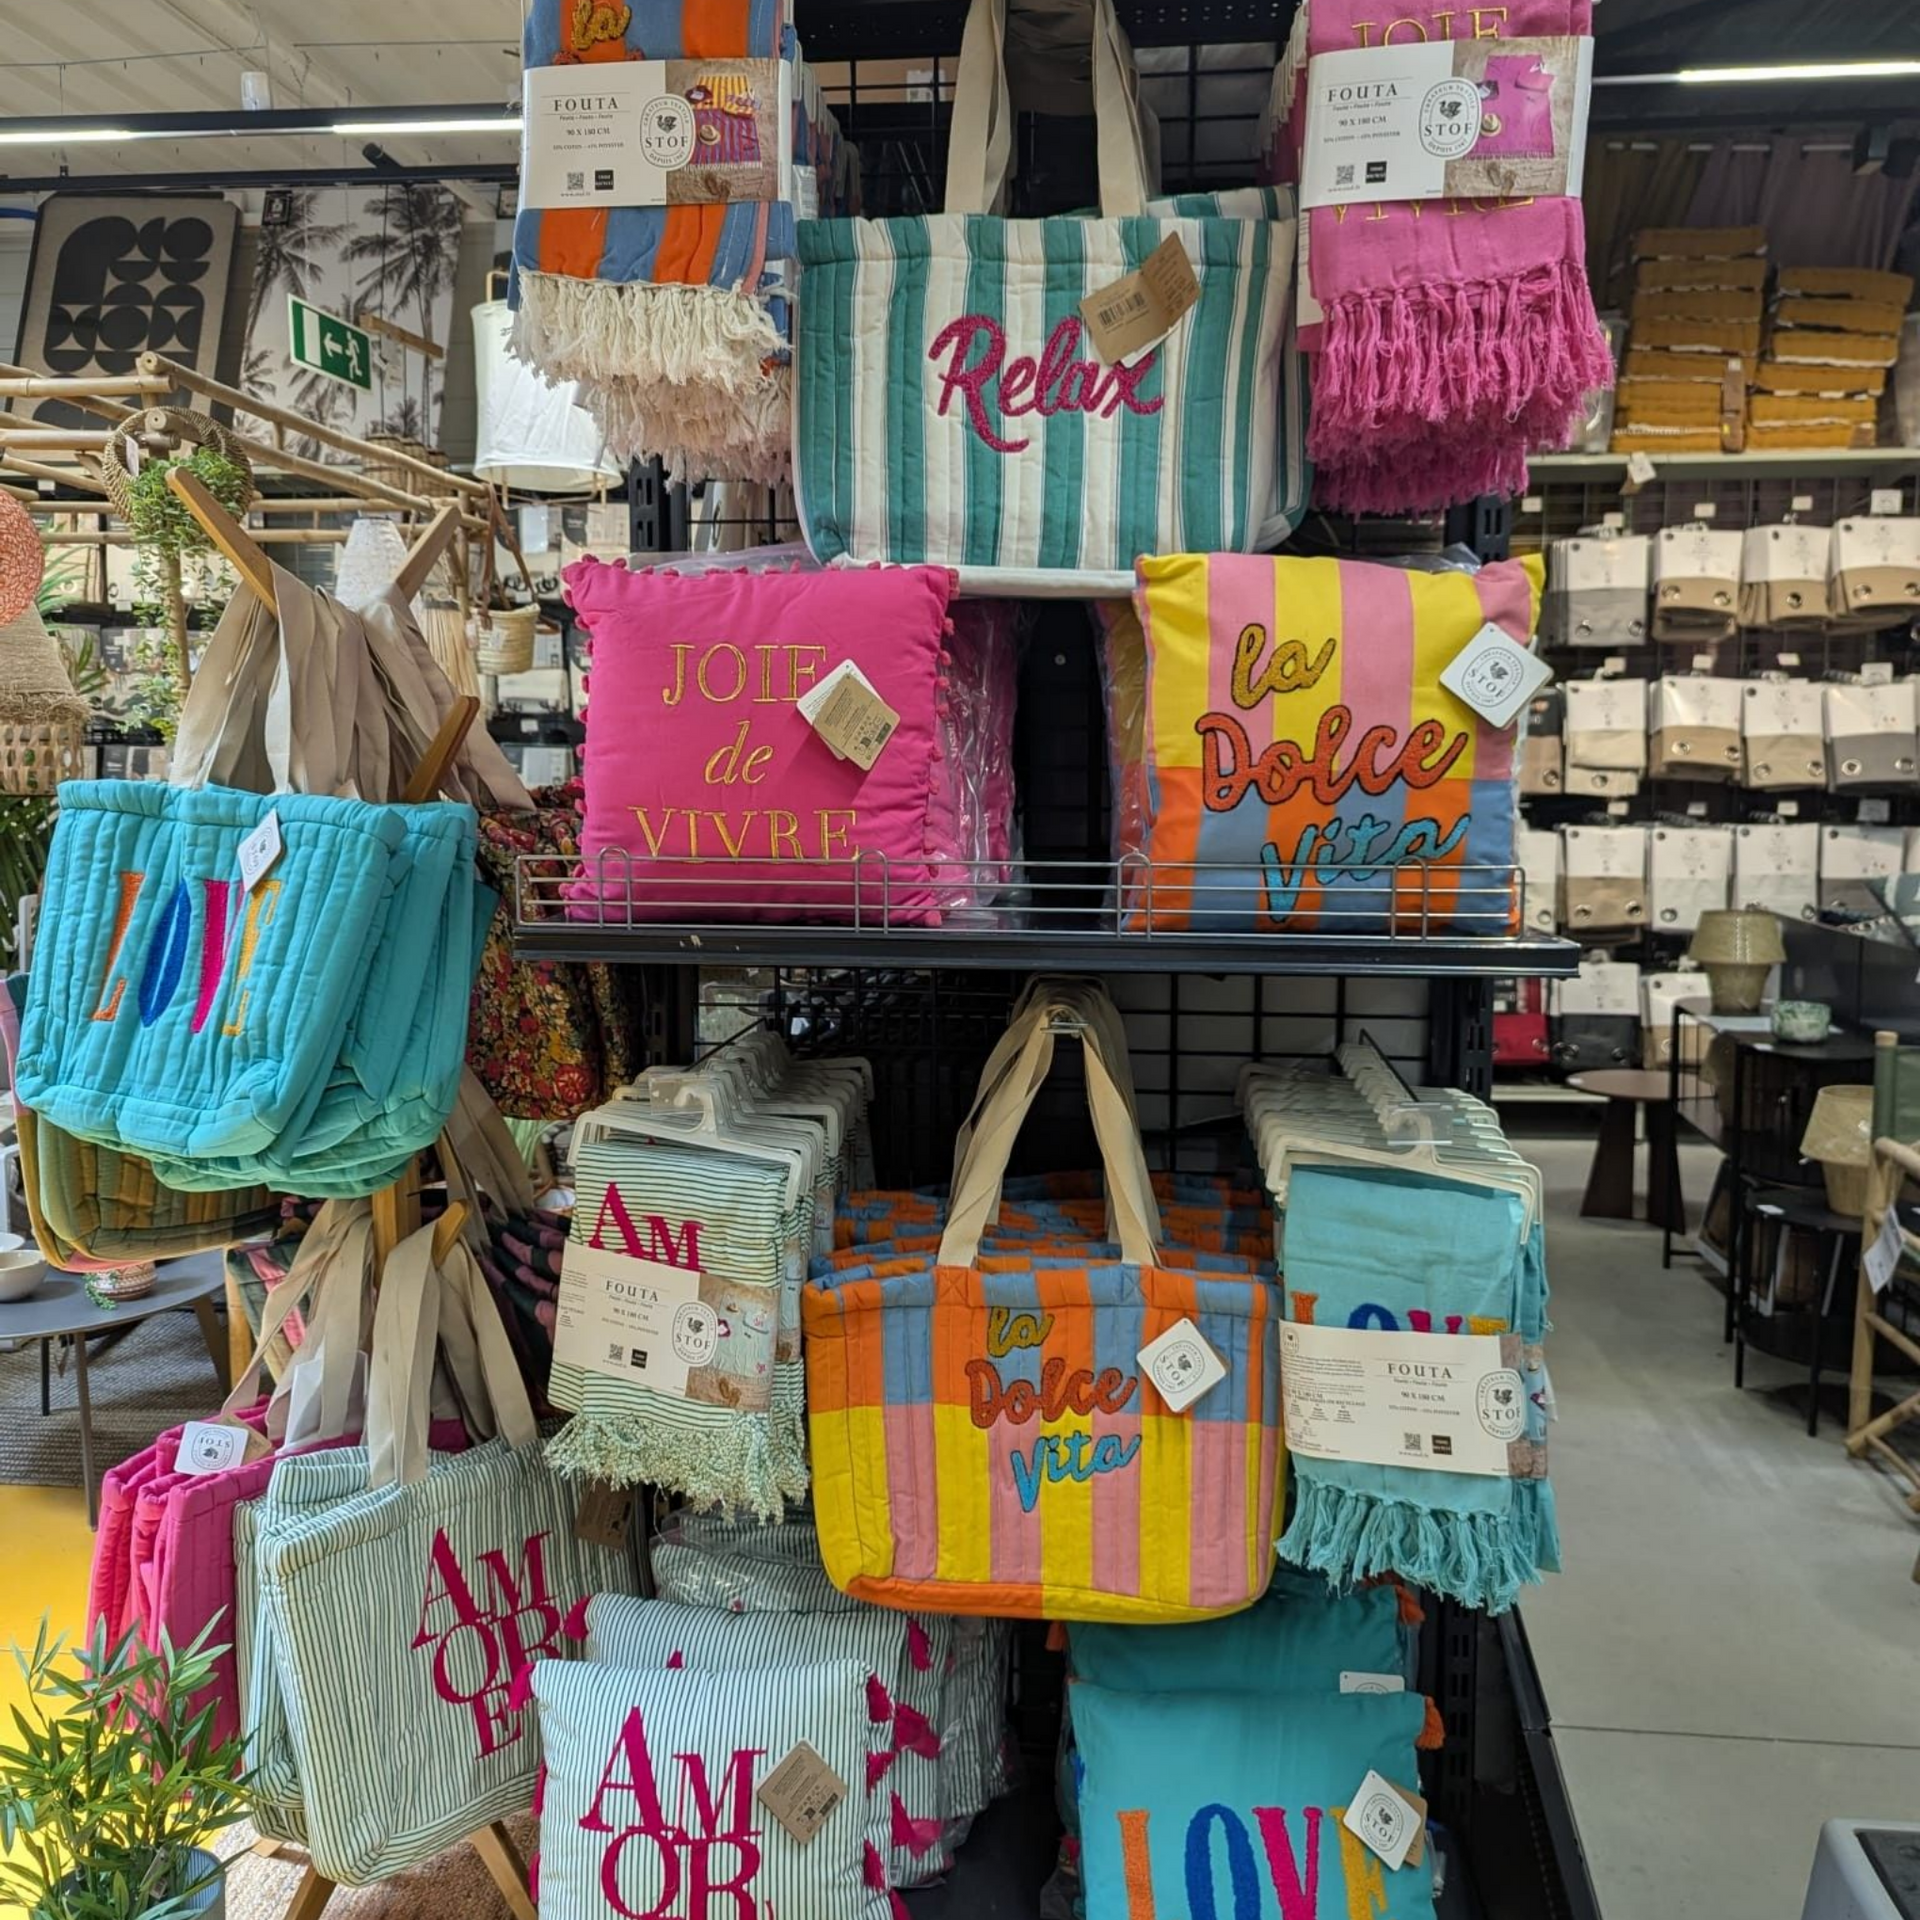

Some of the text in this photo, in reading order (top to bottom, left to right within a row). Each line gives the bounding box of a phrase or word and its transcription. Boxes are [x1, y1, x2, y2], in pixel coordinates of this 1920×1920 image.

[554, 97, 618, 111] FOUTA
[1328, 82, 1398, 102] FOUTA
[597, 127, 610, 135] CM
[1372, 115, 1387, 124] CM
[1424, 122, 1472, 137] STOF
[645, 136, 689, 149] STOF
[927, 313, 1165, 453] Relax
[662, 643, 828, 706] JOIE
[1230, 623, 1337, 709] la
[1468, 667, 1505, 698] STOF
[703, 720, 774, 786] de
[1195, 705, 1469, 812] Dolce
[627, 805, 860, 864] VIVRE
[1261, 813, 1472, 923] Vita
[91, 871, 281, 1036] LOVE
[606, 1280, 659, 1303] FOUTA
[675, 1332, 711, 1350] STOF
[986, 1305, 1054, 1358] la
[1159, 1354, 1187, 1387] STOF
[1387, 1363, 1452, 1379] FOUTA
[964, 1357, 1139, 1429] Dolce
[1010, 1430, 1142, 1513] Vita
